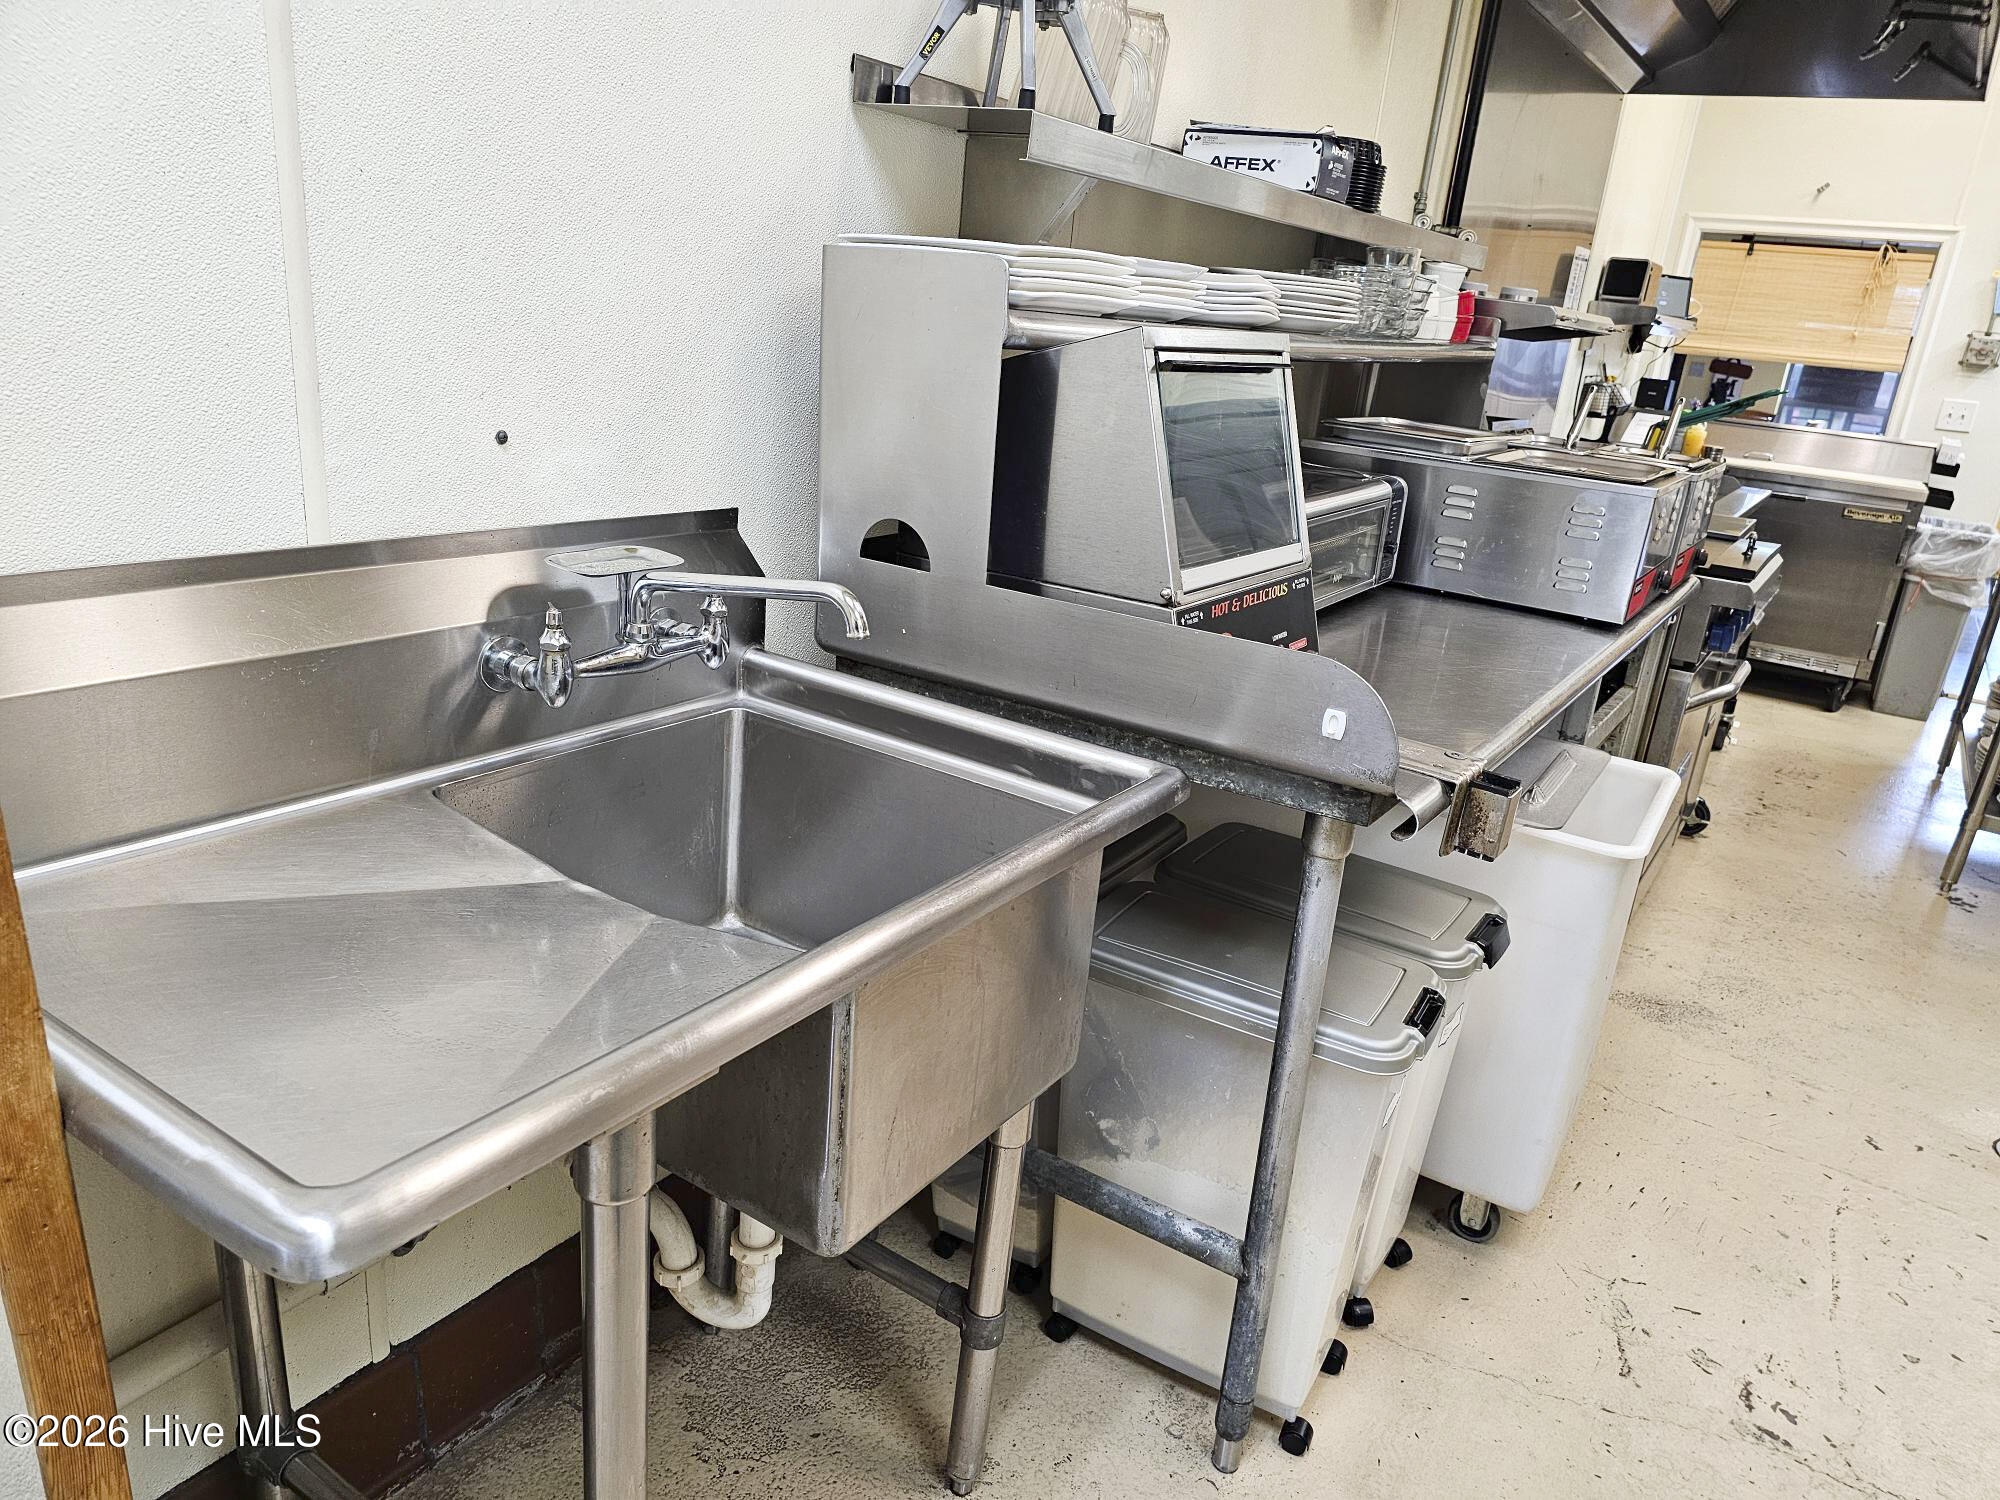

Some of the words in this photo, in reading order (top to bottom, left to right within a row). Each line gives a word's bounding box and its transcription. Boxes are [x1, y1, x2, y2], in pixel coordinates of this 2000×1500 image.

[922, 31, 941, 55] VEVOR
[1210, 155, 1277, 172] AFFEX
[1211, 601, 1230, 619] HOT
[1231, 598, 1241, 612] &
[1243, 582, 1289, 608] DELICIOUS
